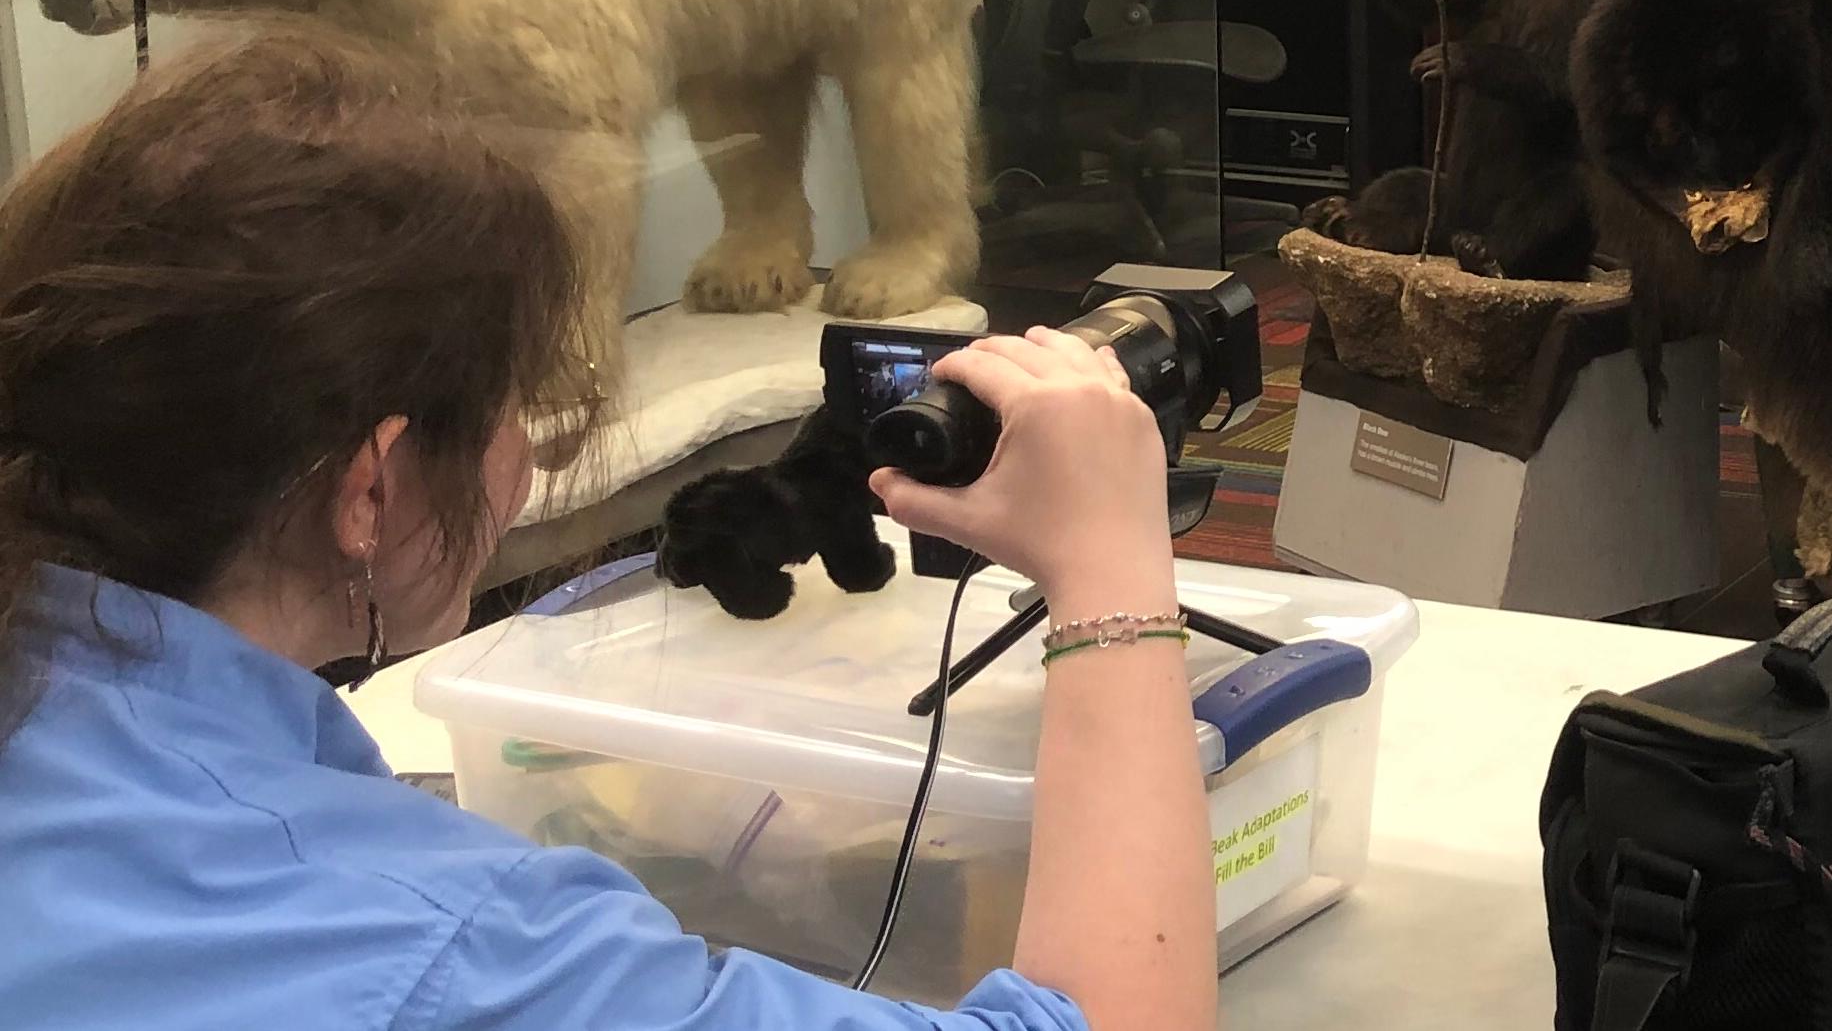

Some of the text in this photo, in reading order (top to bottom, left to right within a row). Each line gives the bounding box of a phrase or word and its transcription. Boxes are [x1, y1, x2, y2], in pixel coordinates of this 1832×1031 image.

[1211, 789, 1310, 856] Beak Adaptations
[1214, 835, 1276, 884] Fill the Bill
